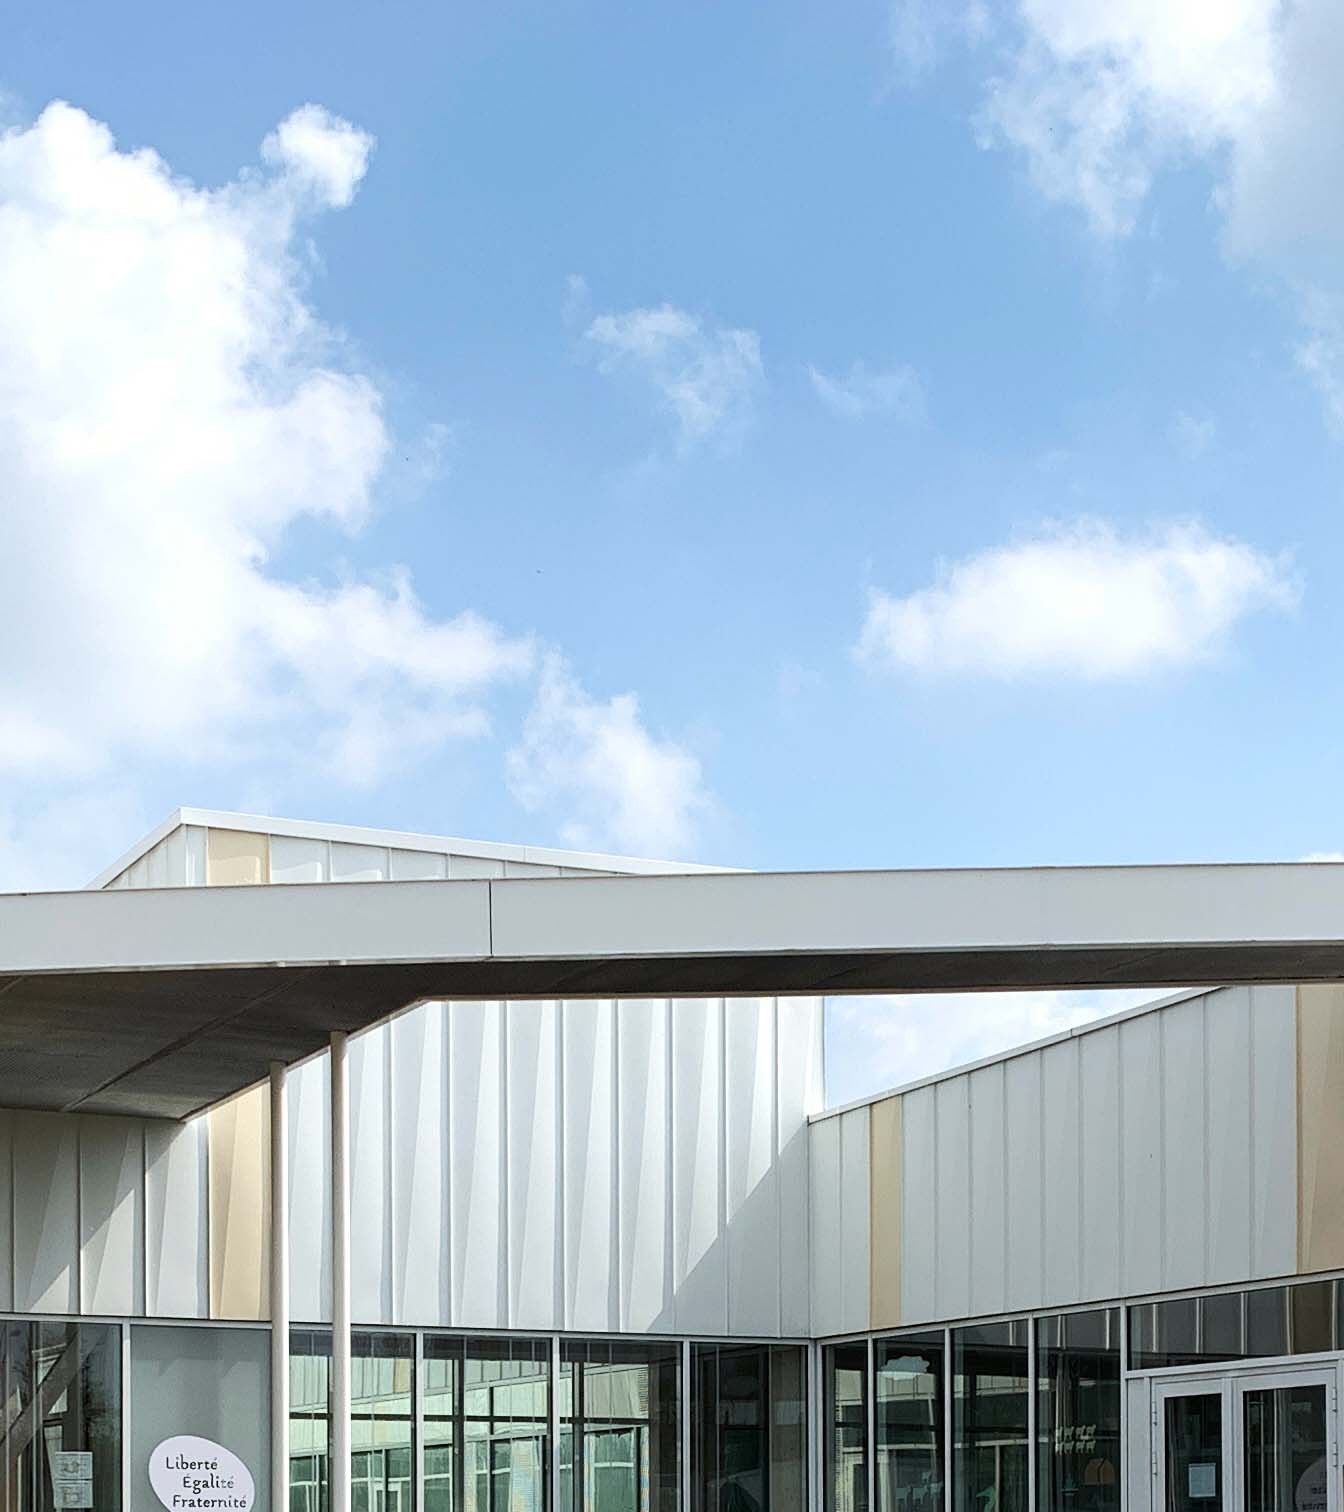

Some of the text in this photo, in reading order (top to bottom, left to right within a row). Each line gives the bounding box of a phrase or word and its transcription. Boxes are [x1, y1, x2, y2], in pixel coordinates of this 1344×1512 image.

[165, 1454, 218, 1470] Liberté
[183, 1473, 234, 1494] Égalité
[172, 1494, 247, 1508] Fraternité
